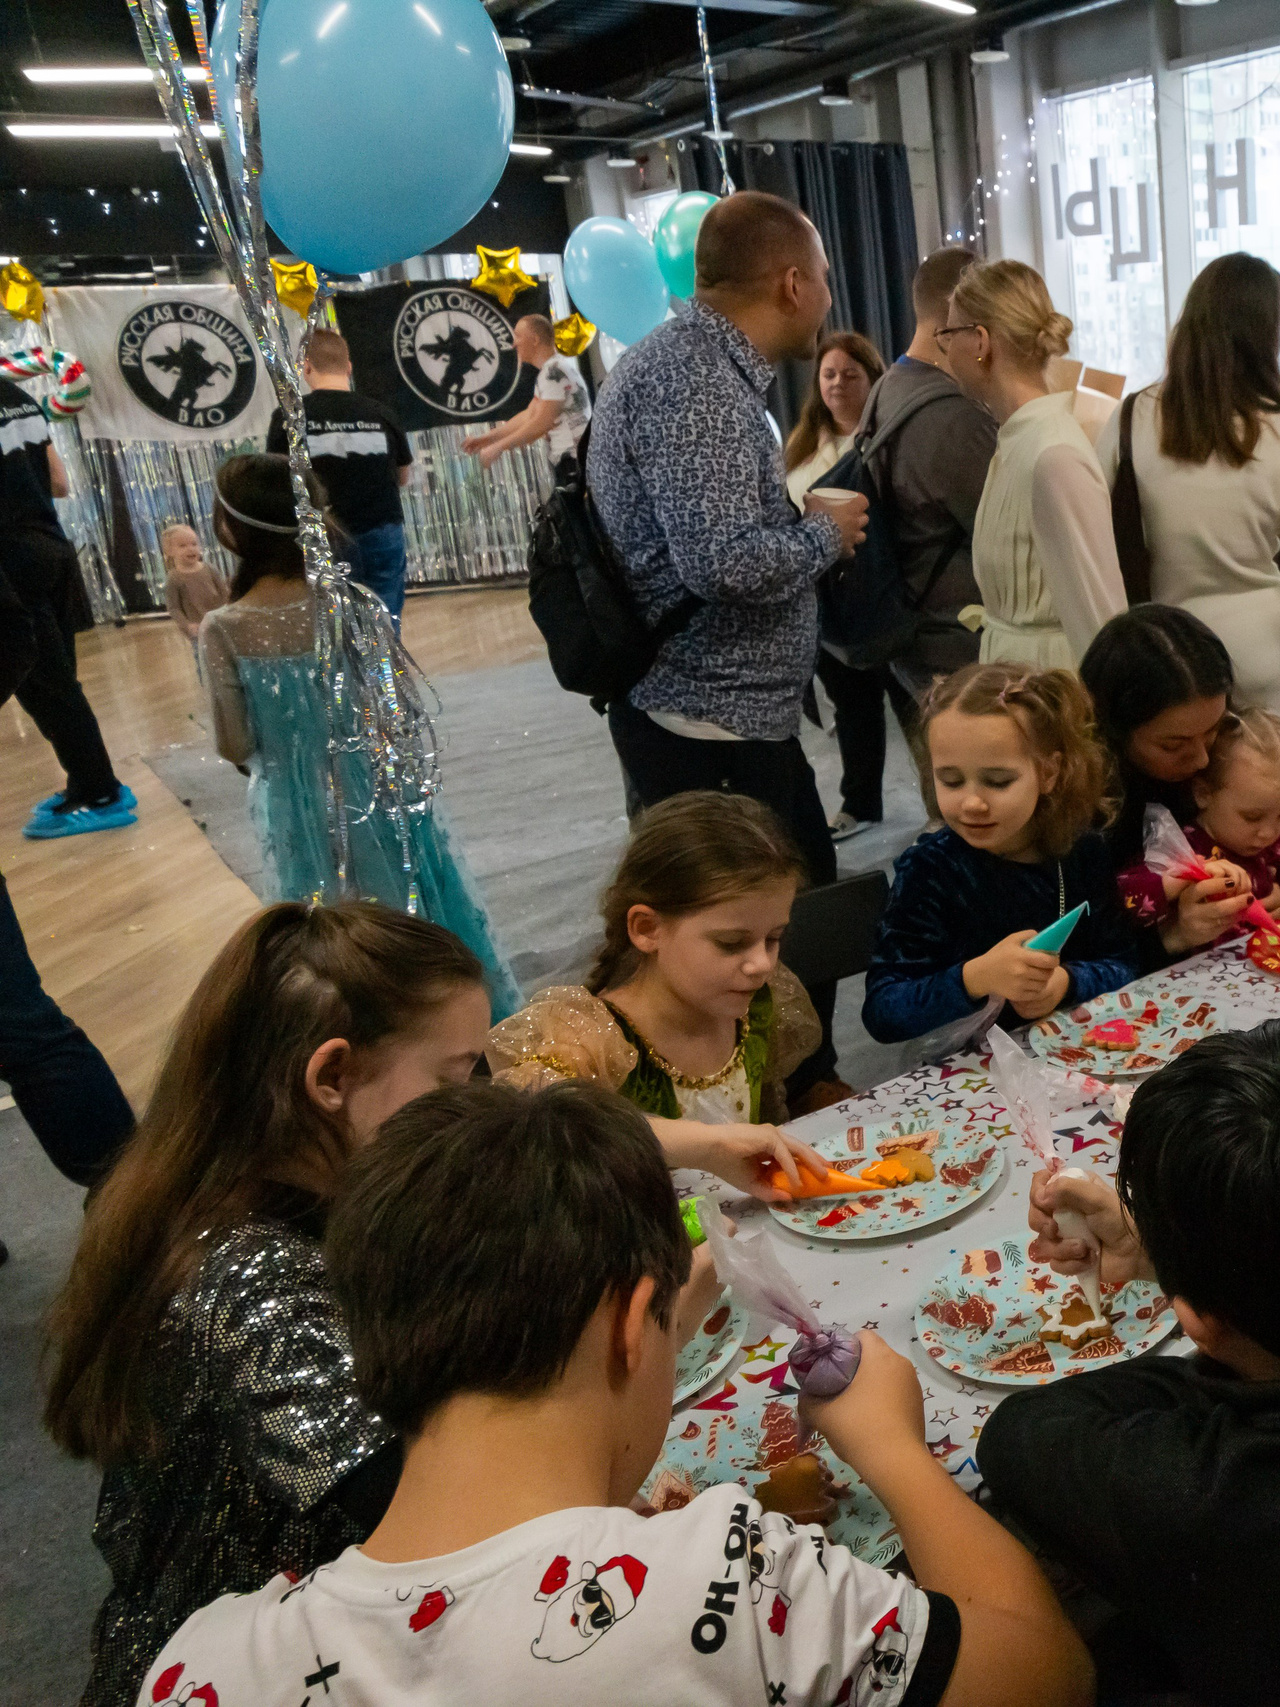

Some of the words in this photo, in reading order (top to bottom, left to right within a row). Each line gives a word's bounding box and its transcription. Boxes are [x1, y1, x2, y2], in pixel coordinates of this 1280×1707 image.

[121, 304, 175, 367] РУССКАЯ
[178, 303, 253, 364] ОБЩИНА
[400, 294, 444, 358] РУССКАЯ
[446, 293, 514, 351] ОБЩИНА
[178, 407, 226, 427] ВАО
[447, 392, 490, 411] ВАО
